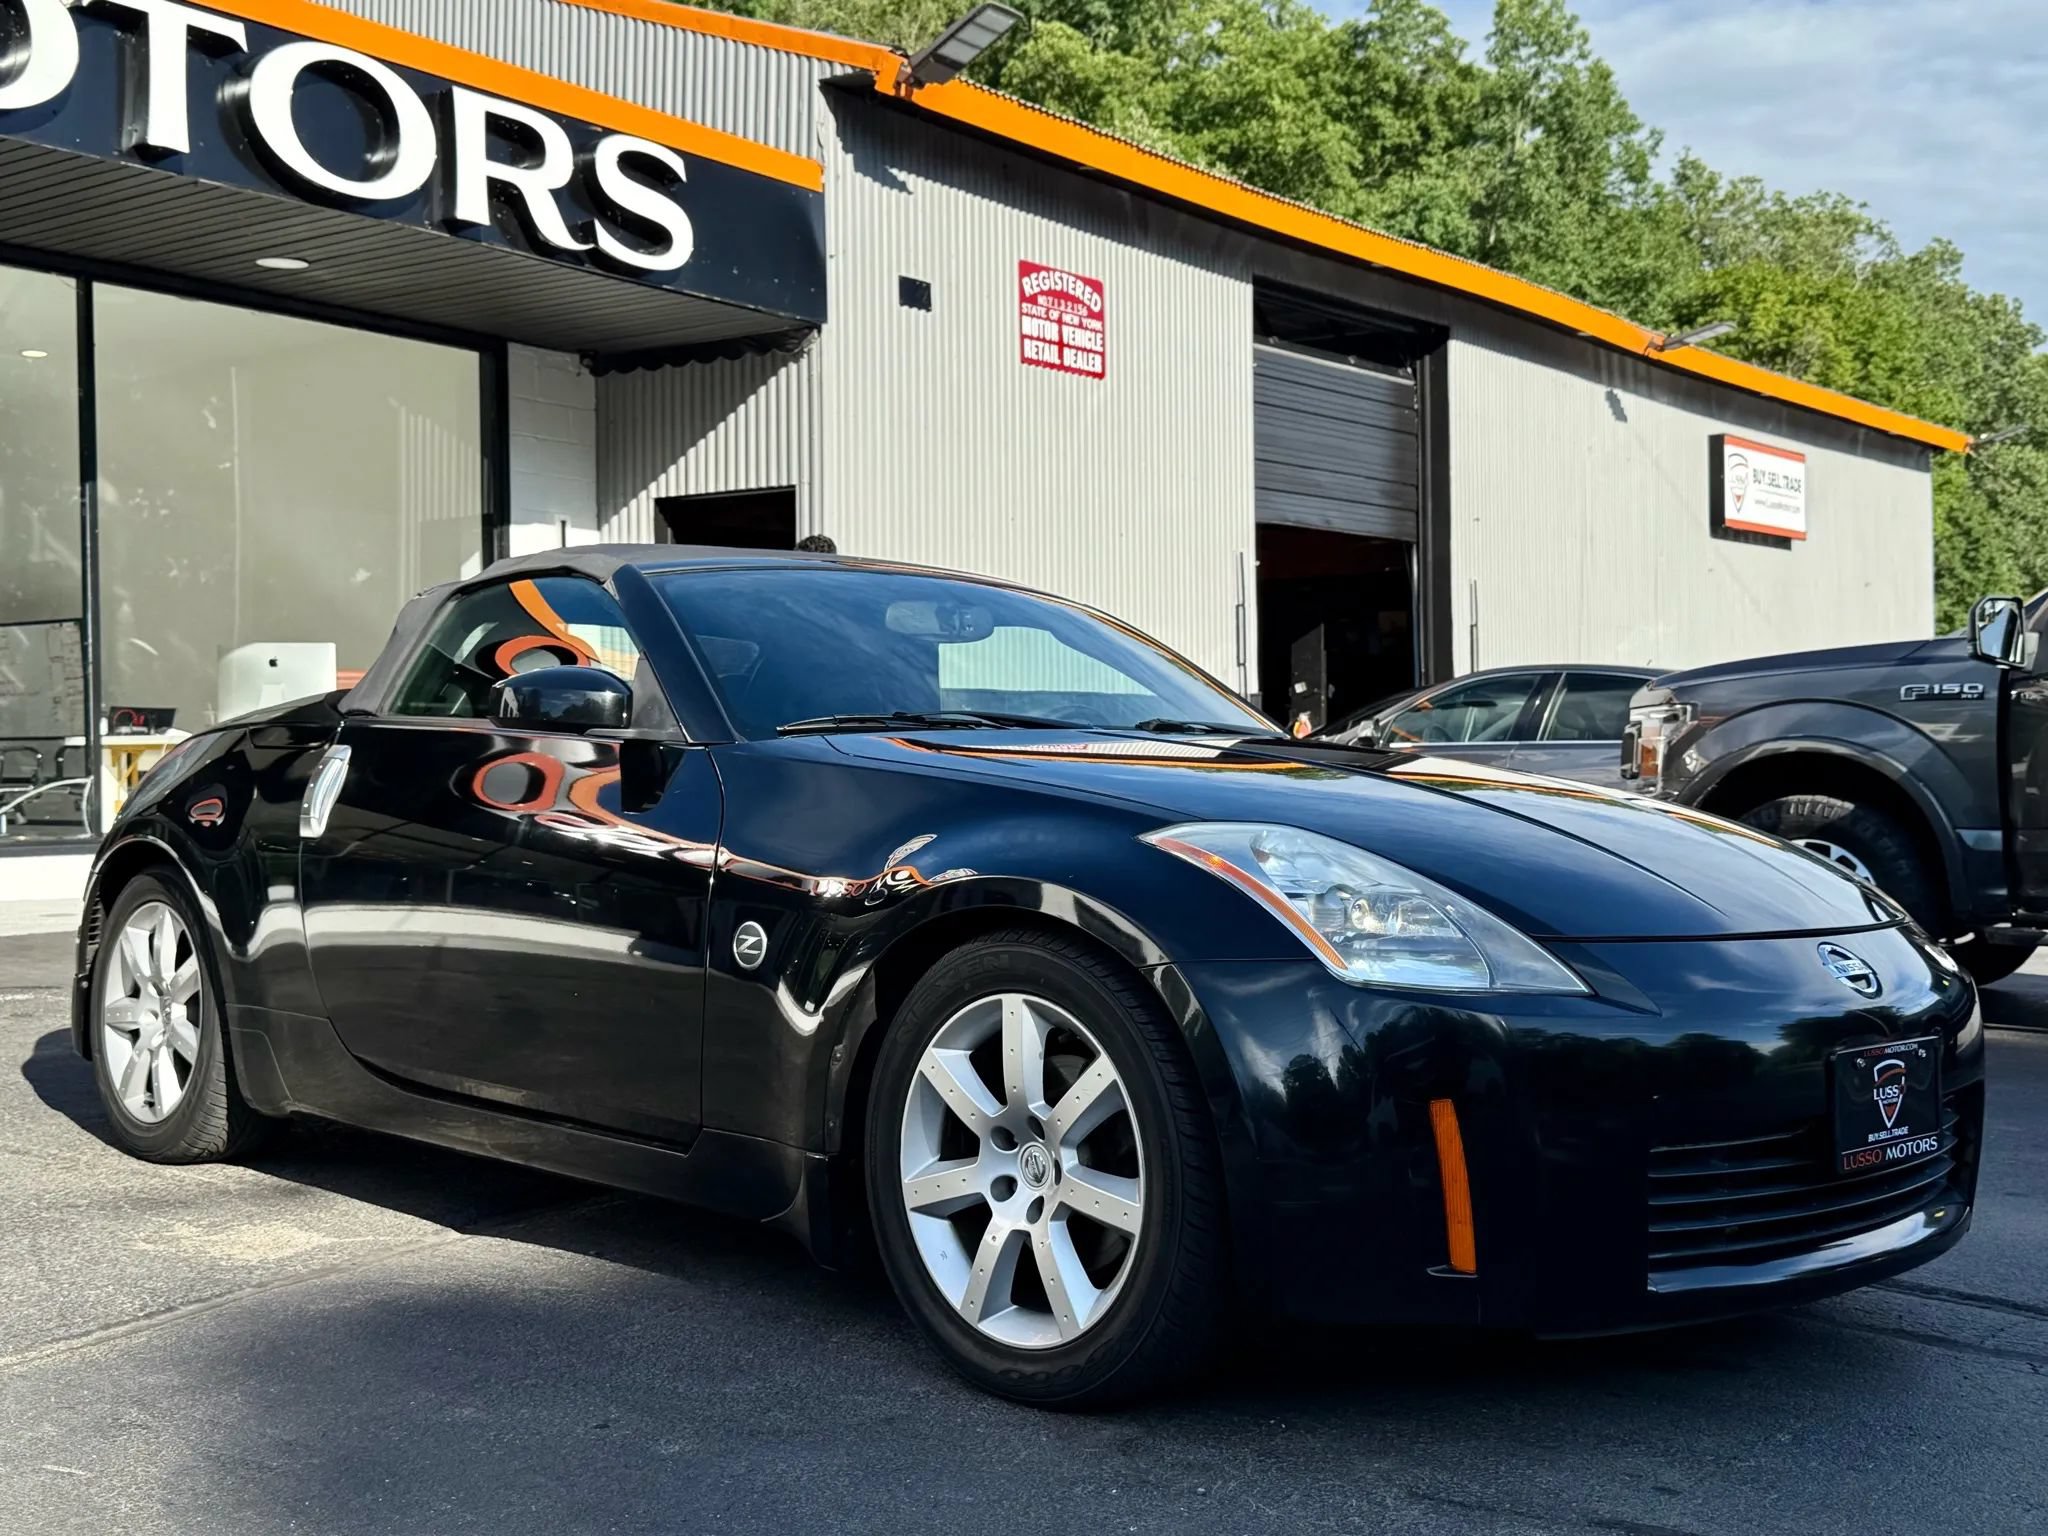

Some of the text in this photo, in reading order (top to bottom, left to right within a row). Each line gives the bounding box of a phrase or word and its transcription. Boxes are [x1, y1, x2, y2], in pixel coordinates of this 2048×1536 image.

[1021, 270, 1101, 312] REGISTERED
[1021, 302, 1103, 331] STATE OF NEW YORK
[1021, 315, 1103, 352] MOTOR VEHICLE
[1023, 338, 1102, 374] RETAIL DEALER
[1843, 1136, 1938, 1170] LUSSO MOTORS
